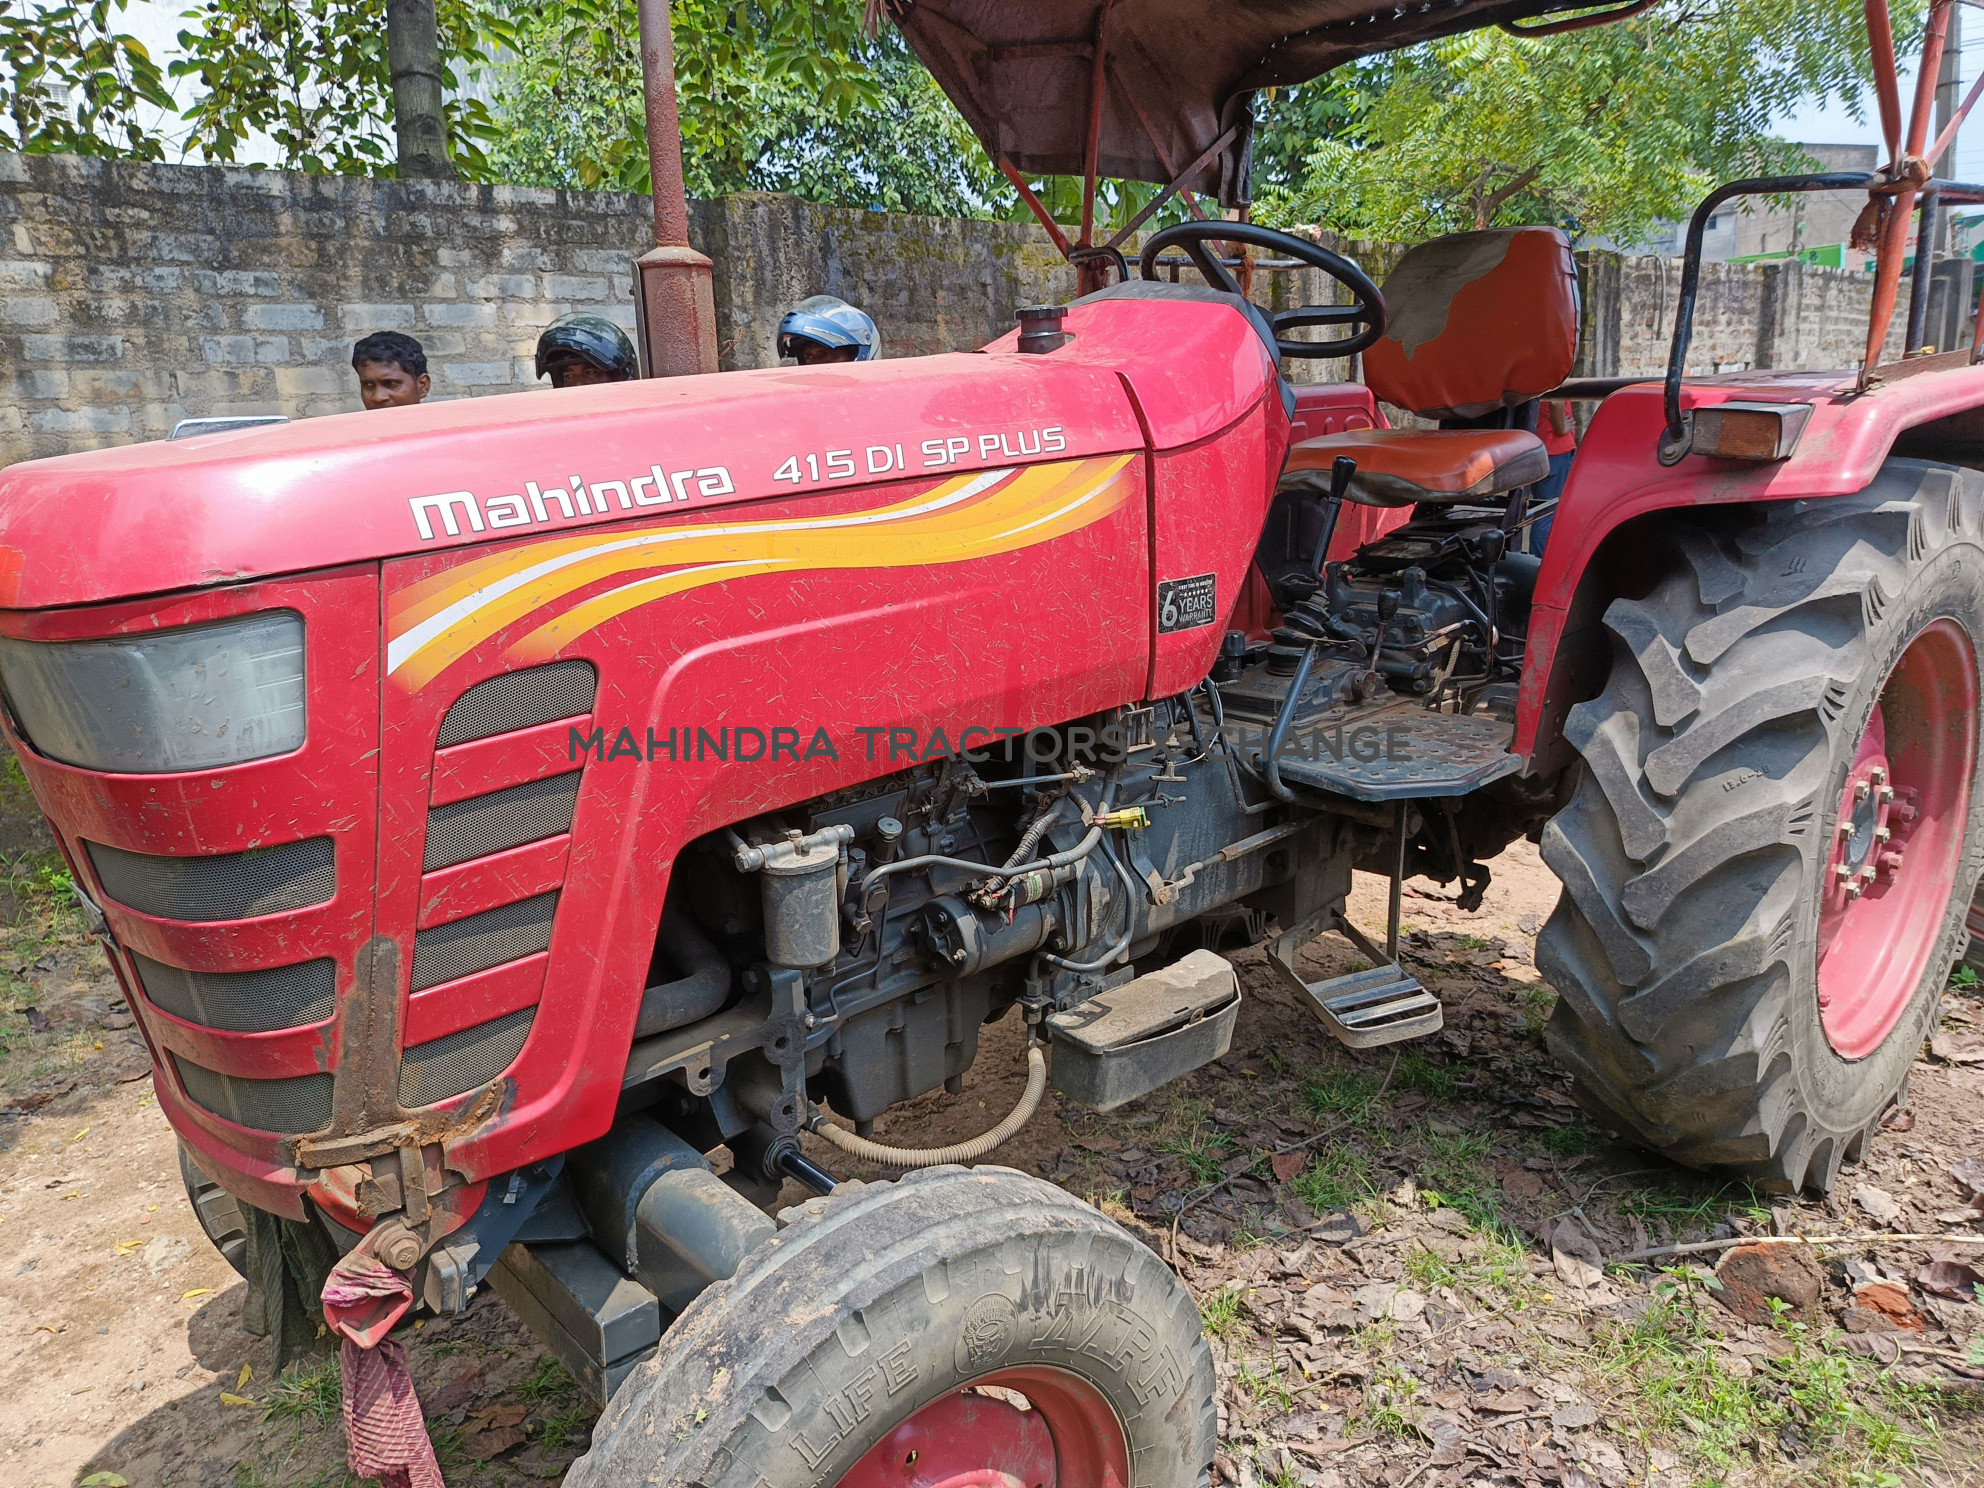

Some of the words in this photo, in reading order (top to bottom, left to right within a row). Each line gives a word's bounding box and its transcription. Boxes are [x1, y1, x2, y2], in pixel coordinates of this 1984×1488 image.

[773, 450, 856, 484] 415
[866, 443, 905, 474] DI
[921, 437, 970, 467] SP
[978, 426, 1066, 460] PLUS
[408, 464, 735, 541] Mahindra
[1161, 590, 1178, 627] 6
[1178, 593, 1213, 613] YEARS
[1178, 608, 1213, 623] WARRANTY
[1028, 1291, 1185, 1406] MRF
[789, 1340, 920, 1471] LIFE
